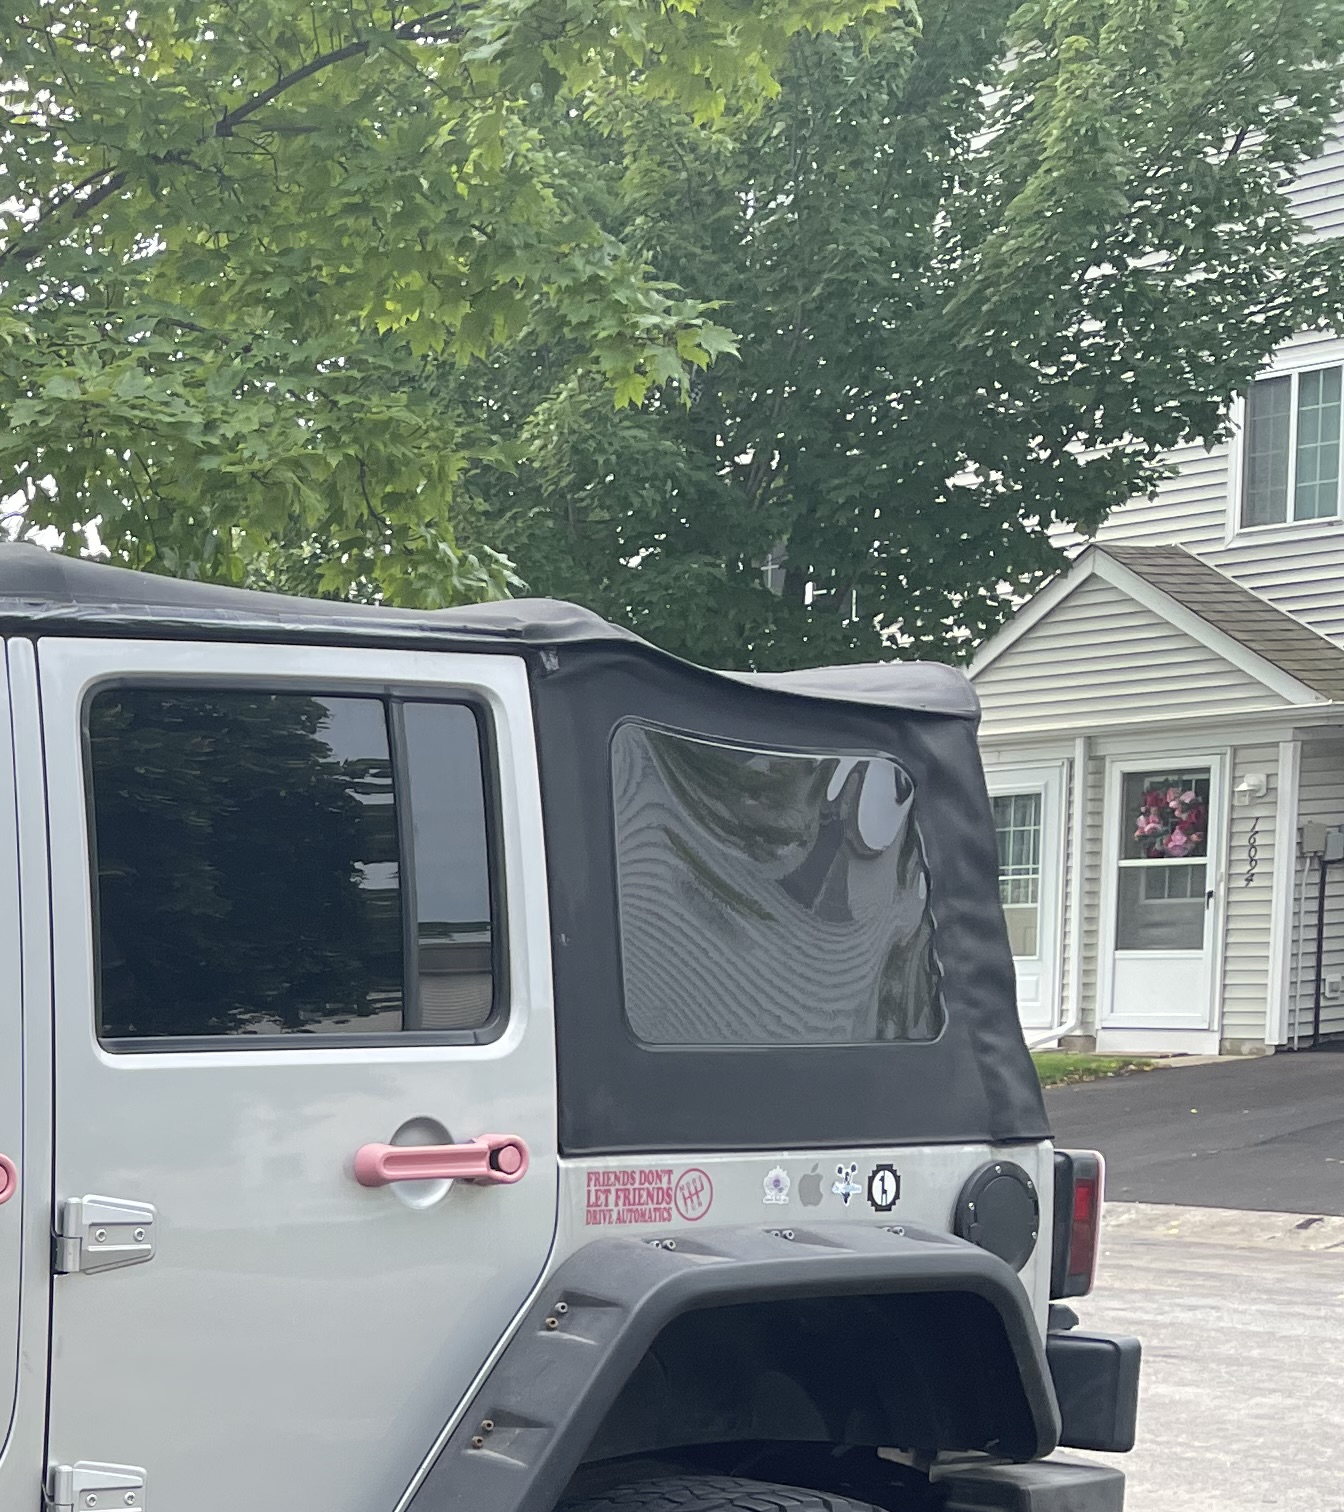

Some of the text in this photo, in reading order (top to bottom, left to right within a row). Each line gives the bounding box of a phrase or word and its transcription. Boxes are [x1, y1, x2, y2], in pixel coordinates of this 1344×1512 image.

[587, 1169, 674, 1188] FRIENDS DON'T
[586, 1188, 612, 1208] LET
[614, 1186, 673, 1208] FRIENDS
[586, 1207, 673, 1226] DRIVE AUTOMATICS
